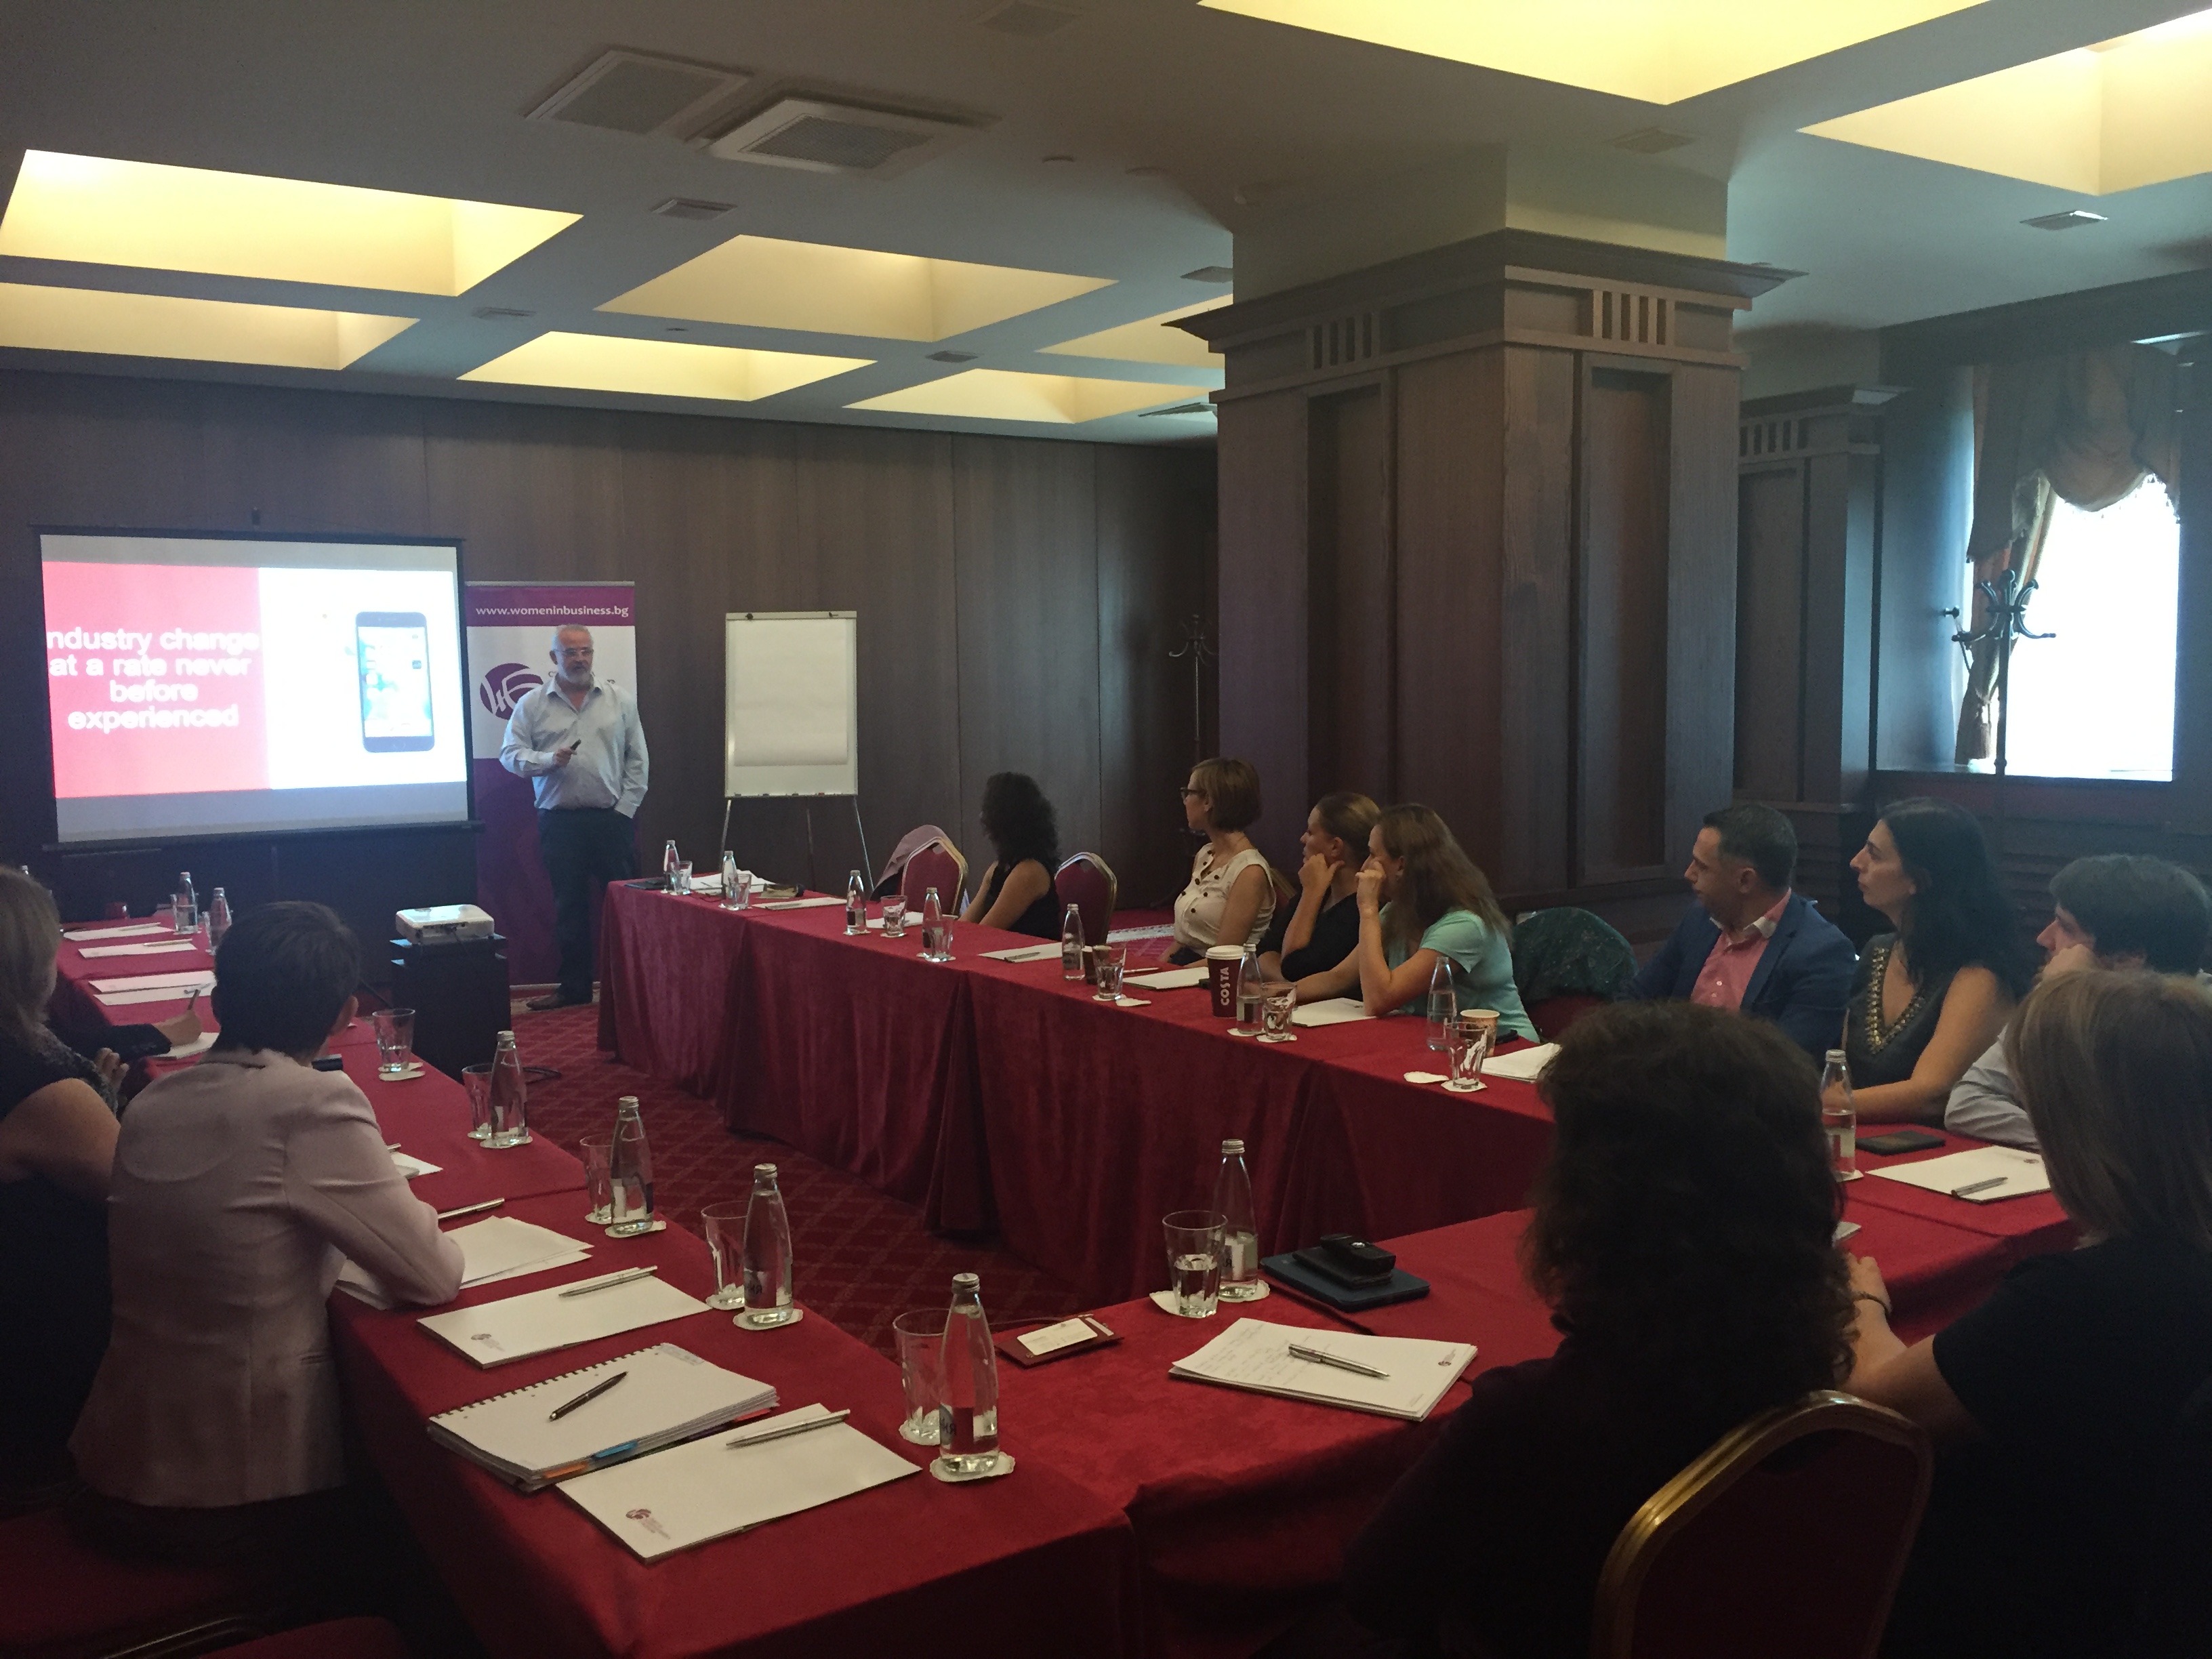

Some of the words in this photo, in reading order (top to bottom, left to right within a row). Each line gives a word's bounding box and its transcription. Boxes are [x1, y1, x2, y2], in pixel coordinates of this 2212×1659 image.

[476, 605, 629, 617] www.womeninbusiness.bg
[160, 627, 260, 655] change
[49, 654, 78, 676] at
[86, 658, 104, 676] a
[113, 655, 167, 676] rate
[175, 658, 252, 676] never
[110, 679, 199, 702] before
[68, 703, 239, 734] experienced
[1220, 966, 1230, 1006] COSTA
